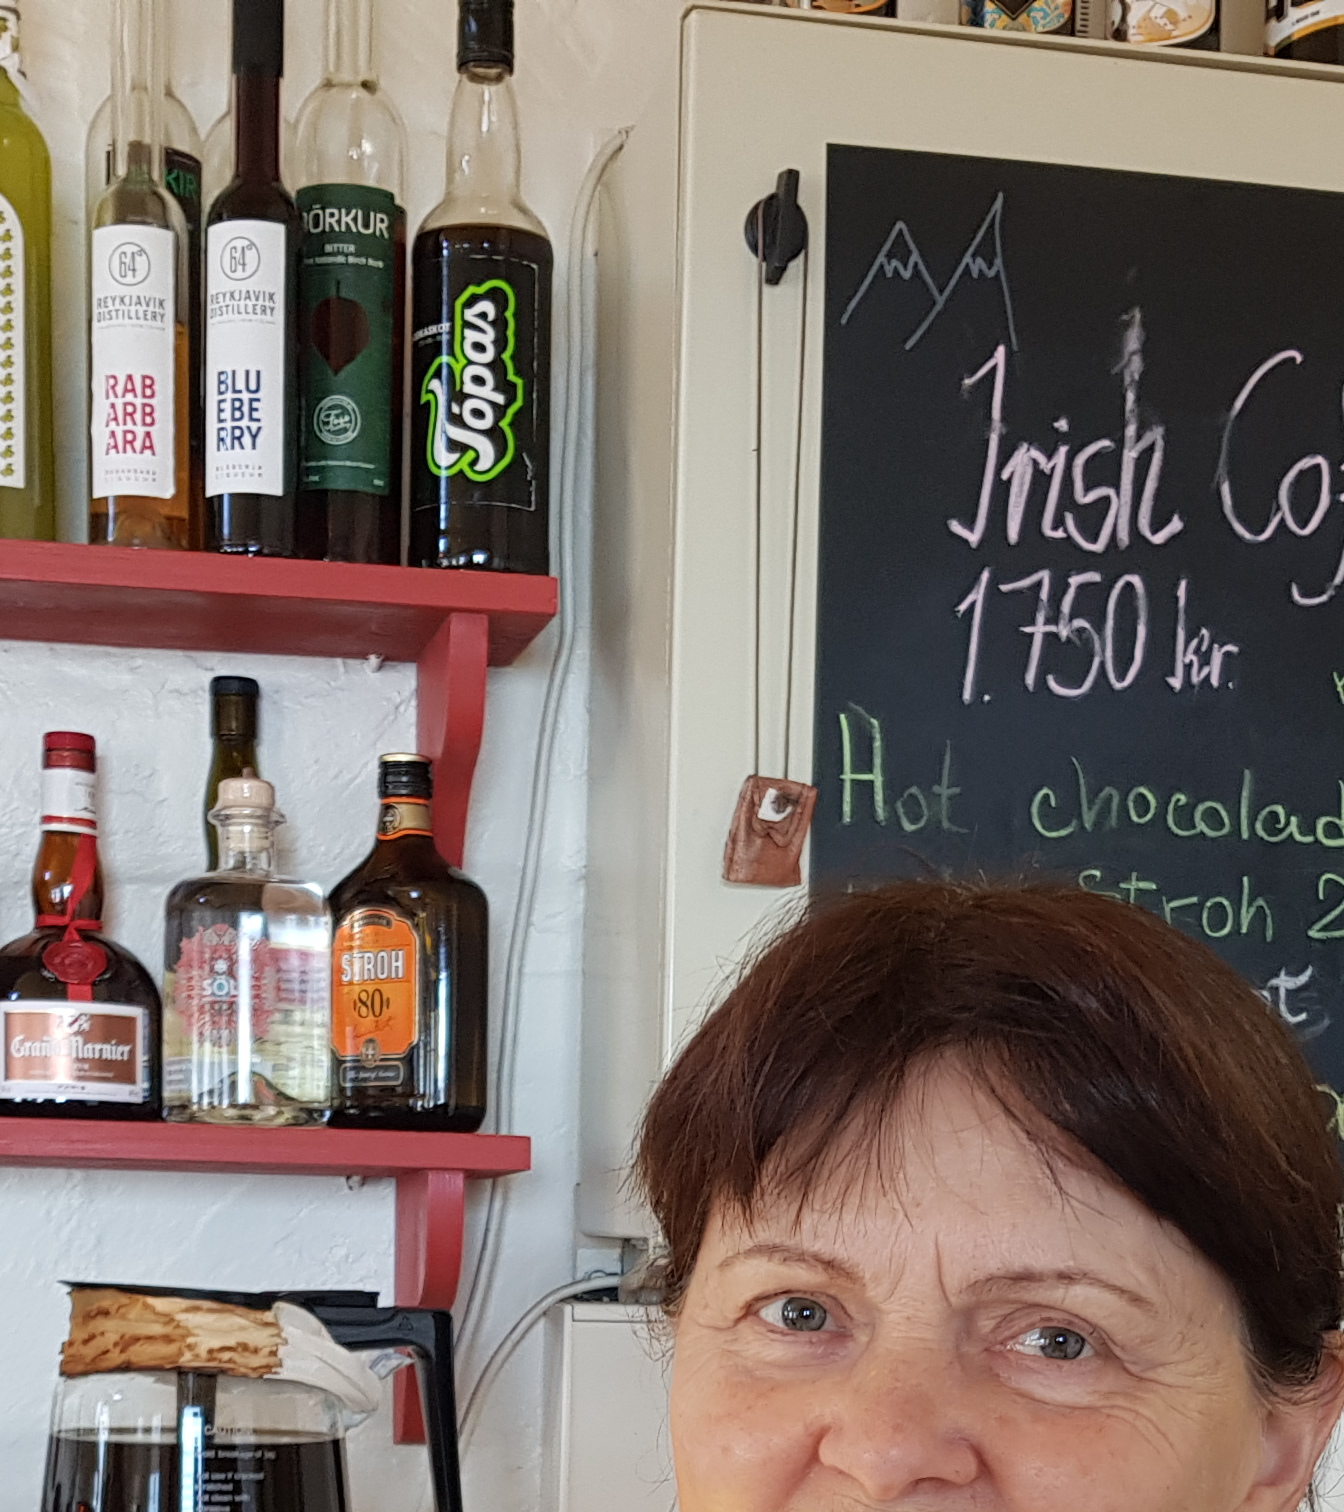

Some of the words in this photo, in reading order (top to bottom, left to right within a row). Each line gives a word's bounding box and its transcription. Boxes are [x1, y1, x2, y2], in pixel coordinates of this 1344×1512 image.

[96, 294, 166, 311] REYKJAVIK
[209, 288, 277, 308] REYKJAVIK
[209, 303, 276, 320] DISTILLERY
[96, 308, 166, 324] DISTILLERY
[105, 373, 156, 401] RAB
[216, 369, 262, 396] BLU
[105, 401, 157, 428] ARB
[216, 397, 262, 424] EBE
[105, 429, 157, 457] ARA
[216, 425, 263, 452] RRY
[947, 306, 1185, 553] Irish
[838, 702, 969, 834] Hot
[341, 949, 405, 985] STROH
[68, 1033, 132, 1061] Marnier
